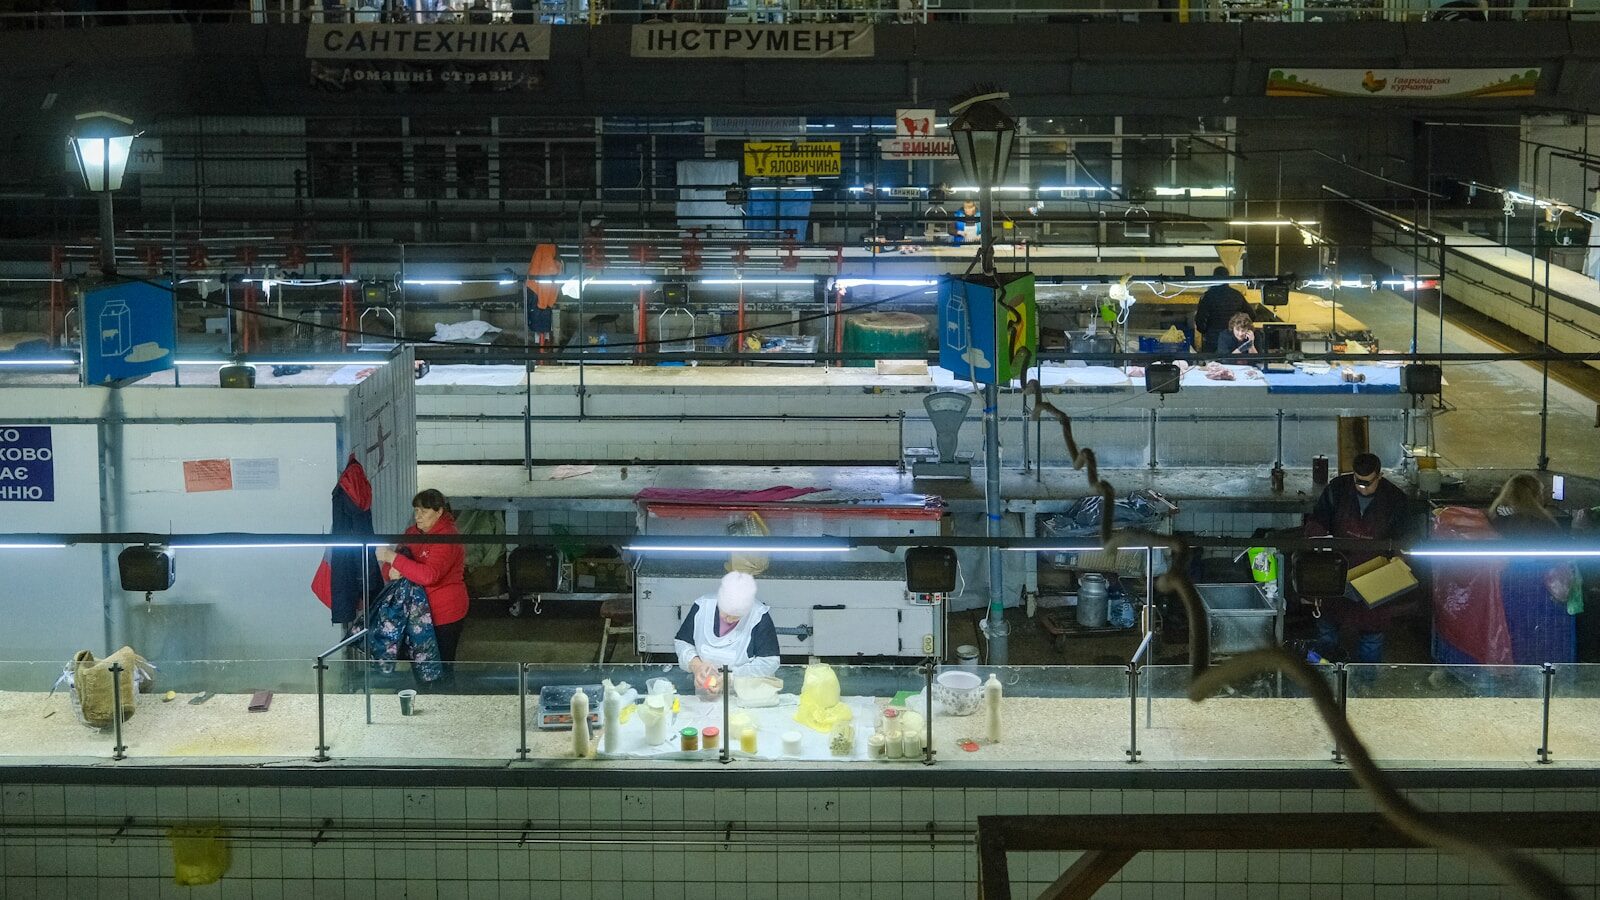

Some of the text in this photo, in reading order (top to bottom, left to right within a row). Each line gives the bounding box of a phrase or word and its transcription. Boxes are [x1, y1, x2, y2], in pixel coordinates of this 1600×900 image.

[323, 30, 531, 52] САНТЕХНІКА
[648, 29, 855, 51] ІНСТРУМЕНТ
[770, 160, 840, 173] ЯЛОВИЧИНА
